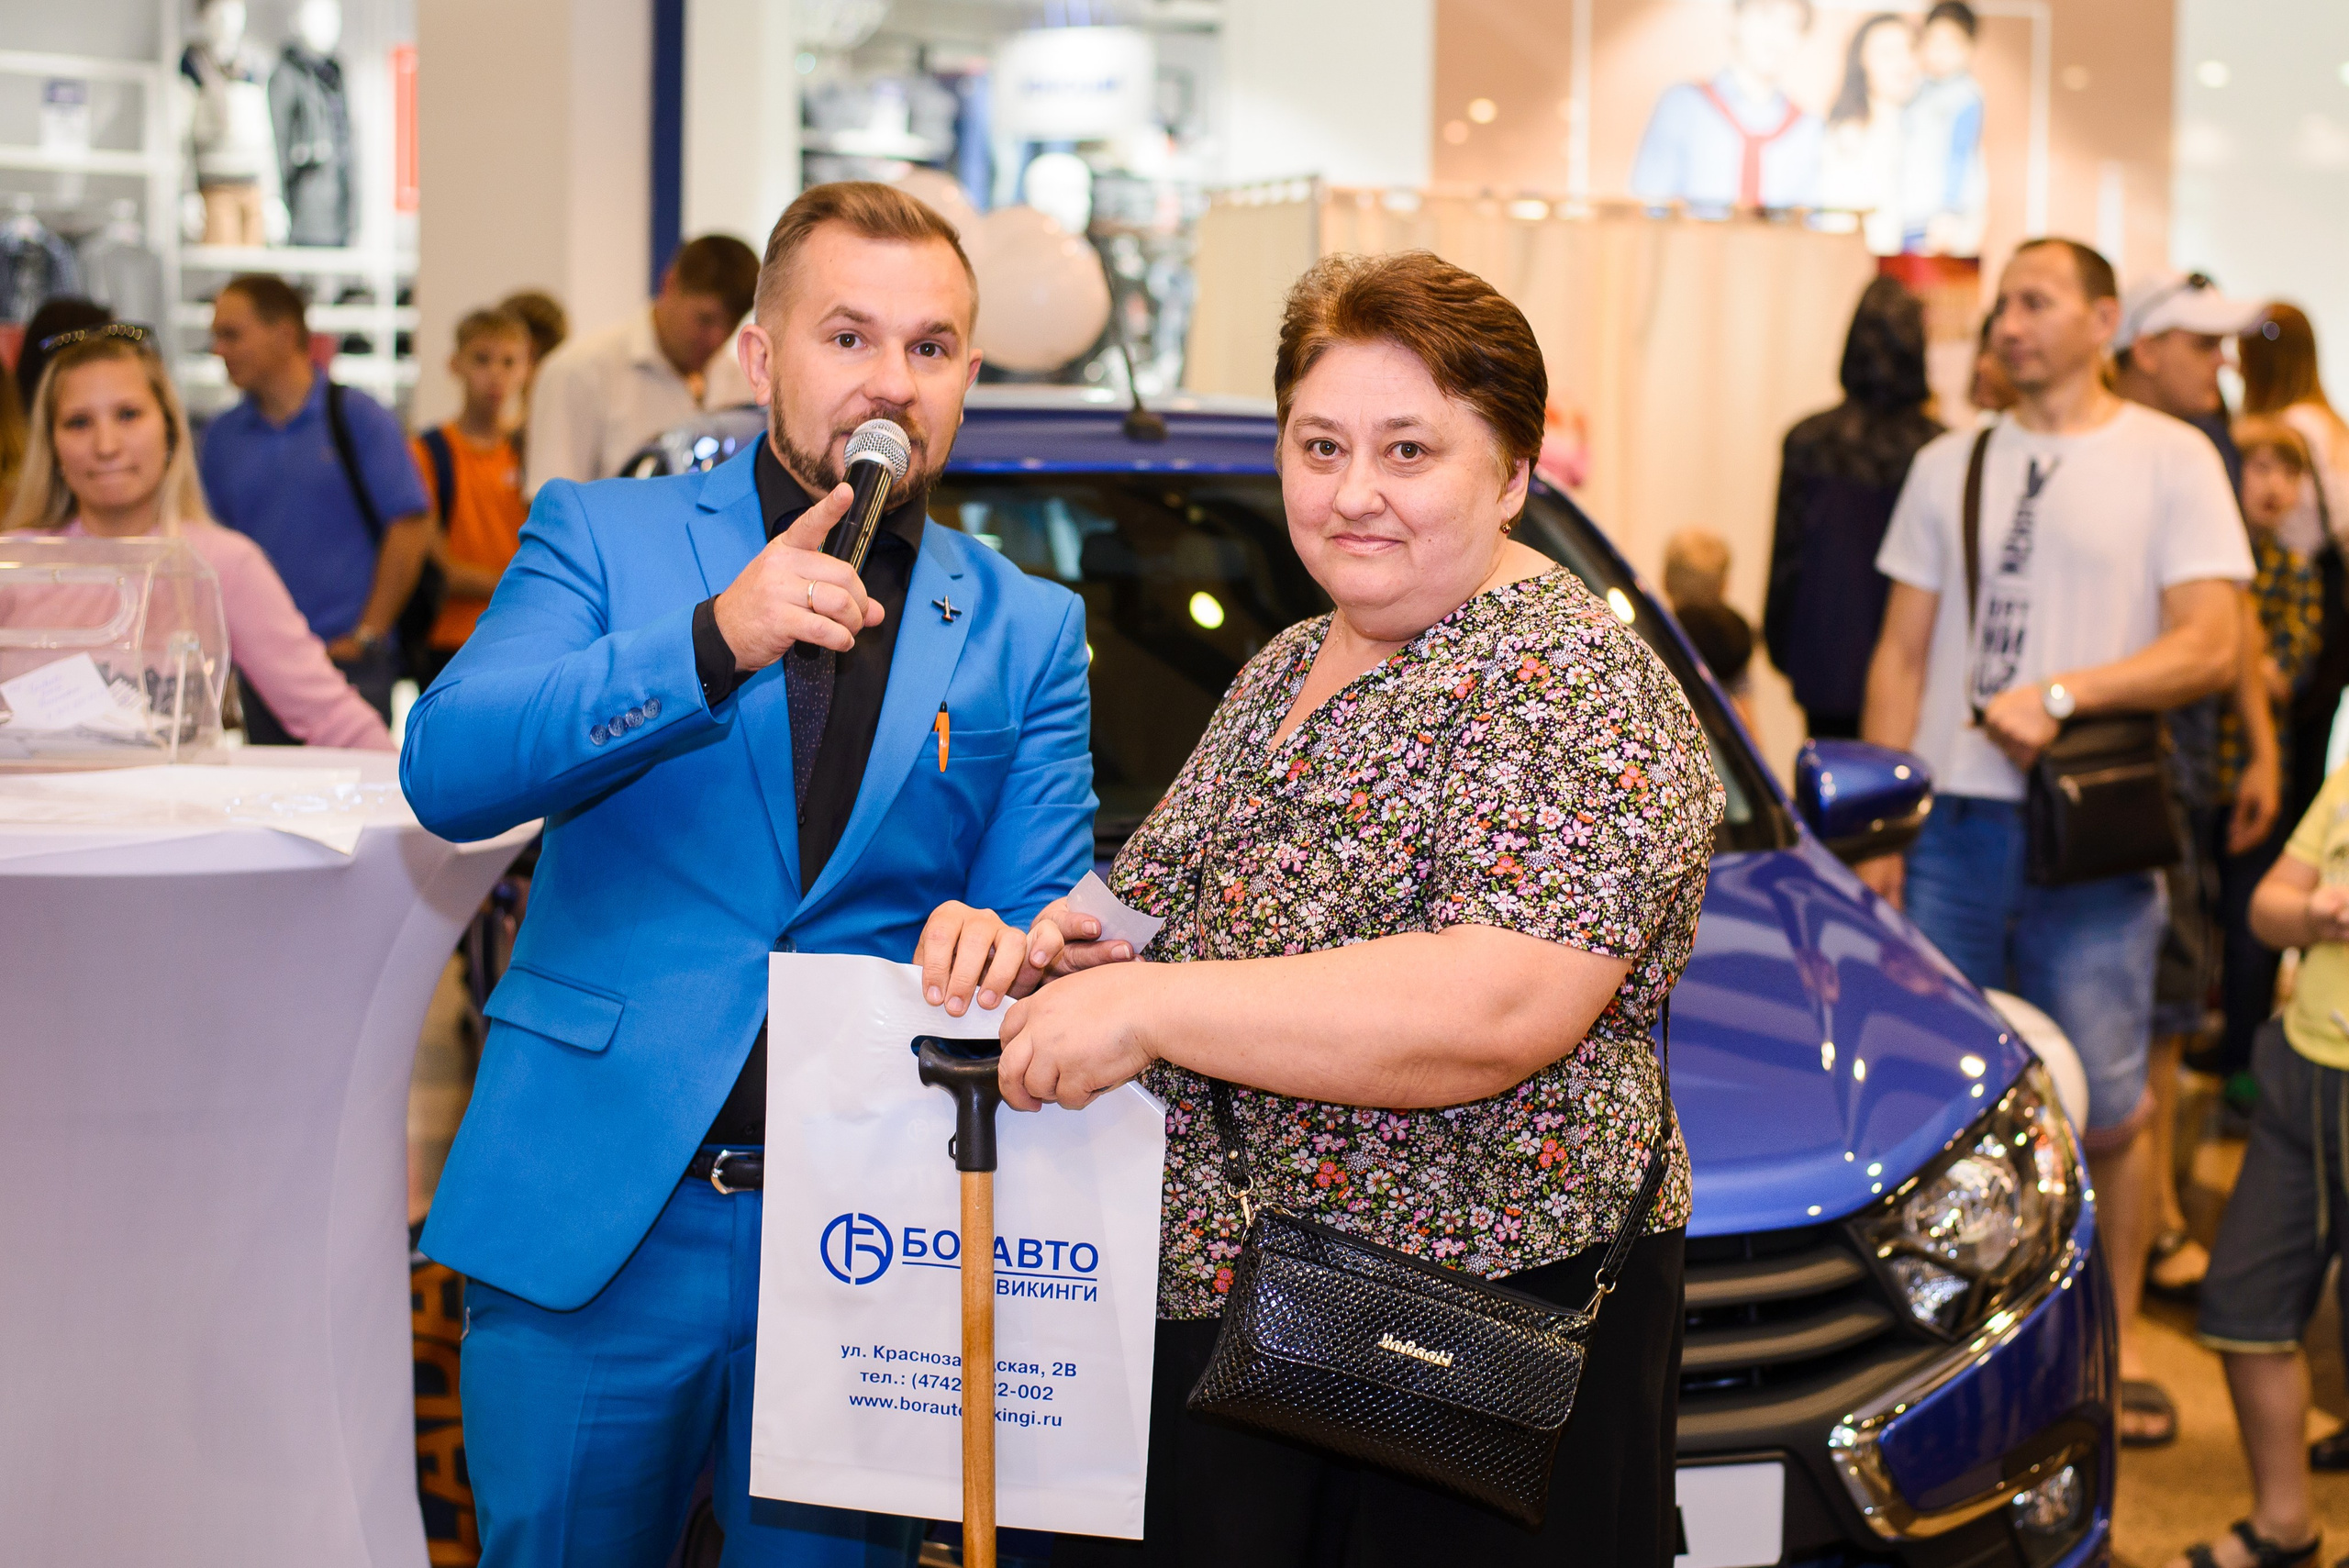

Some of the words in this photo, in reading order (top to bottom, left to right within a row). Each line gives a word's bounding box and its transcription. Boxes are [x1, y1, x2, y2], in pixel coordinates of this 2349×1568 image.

[902, 1227, 1099, 1273] БОАВТО
[996, 1278, 1097, 1302] ВИКИНГИ
[841, 1344, 866, 1359] ул.
[1052, 1362, 1077, 1377] 2В
[860, 1371, 906, 1385] тел.:
